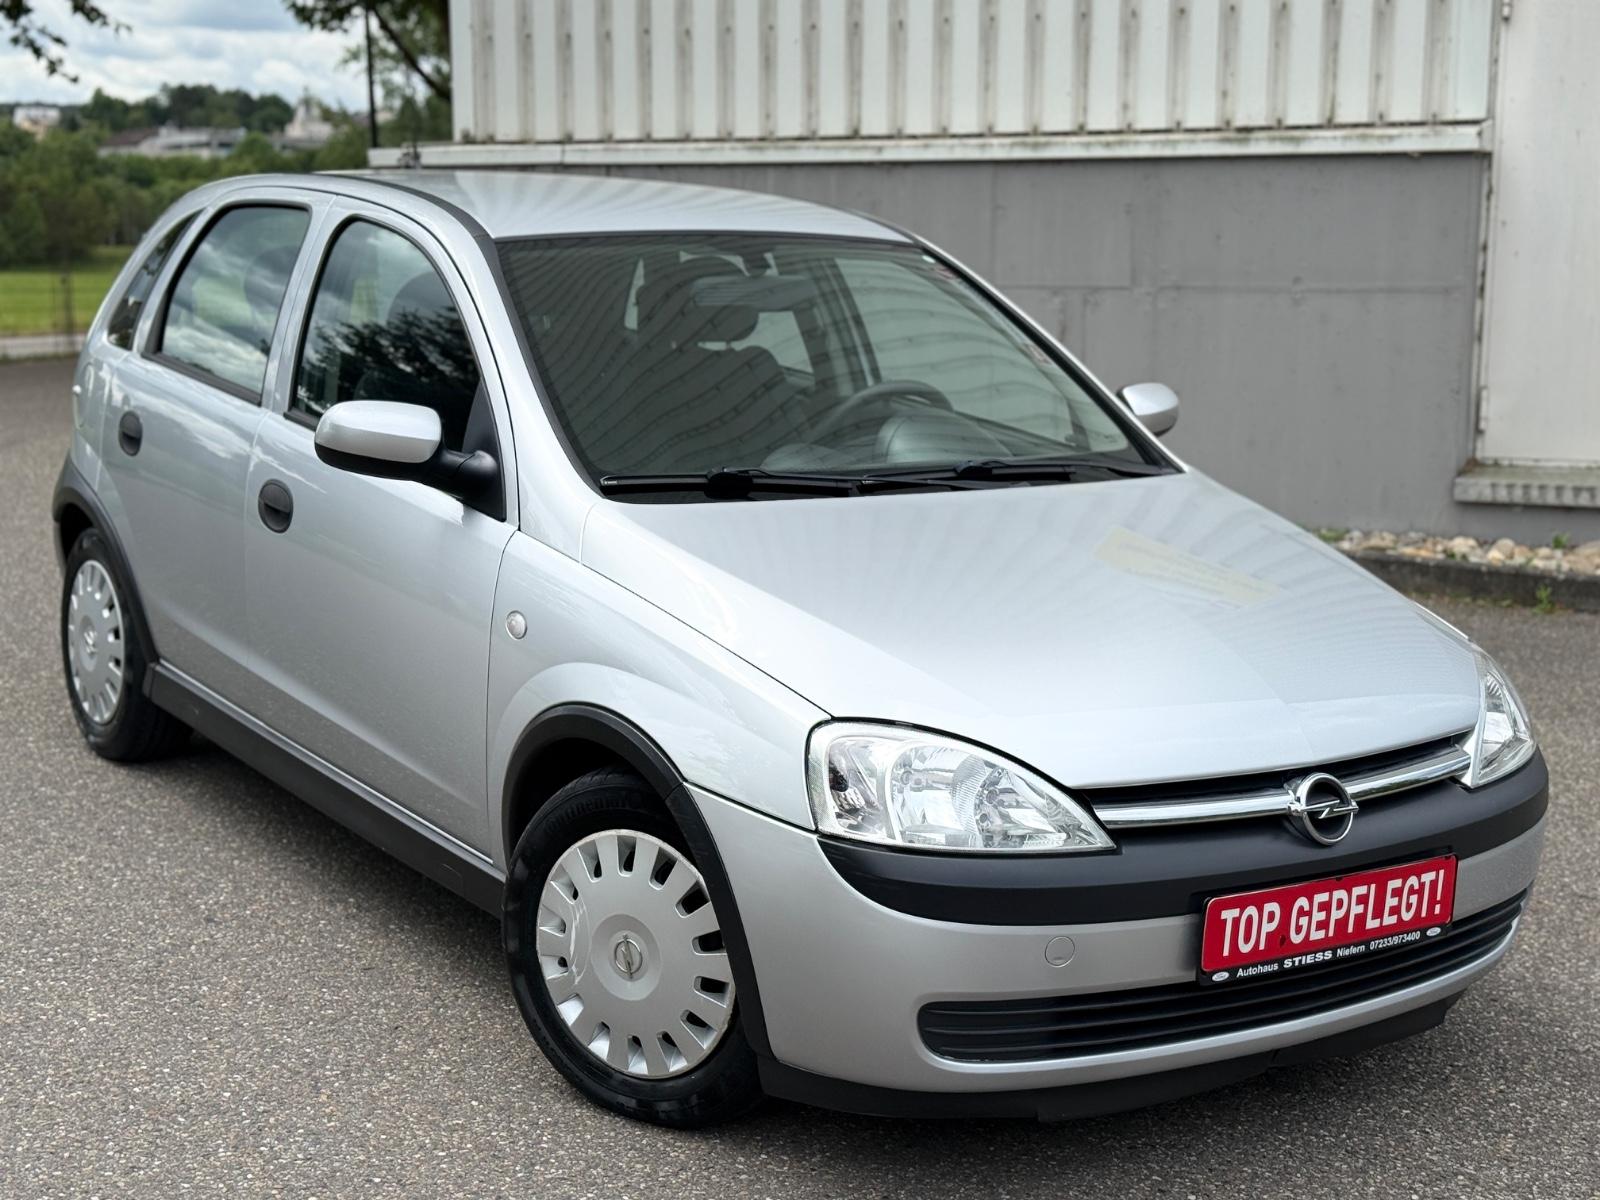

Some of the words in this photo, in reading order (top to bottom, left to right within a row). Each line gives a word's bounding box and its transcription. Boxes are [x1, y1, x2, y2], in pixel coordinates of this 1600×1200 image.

[1220, 901, 1281, 957] TOP
[1289, 869, 1445, 945] GEPFLEGT!
[1236, 962, 1279, 978] Autohaus
[1283, 950, 1333, 969] STIESS
[1336, 944, 1366, 958] Niefern
[1369, 930, 1421, 951] 07233/973400
